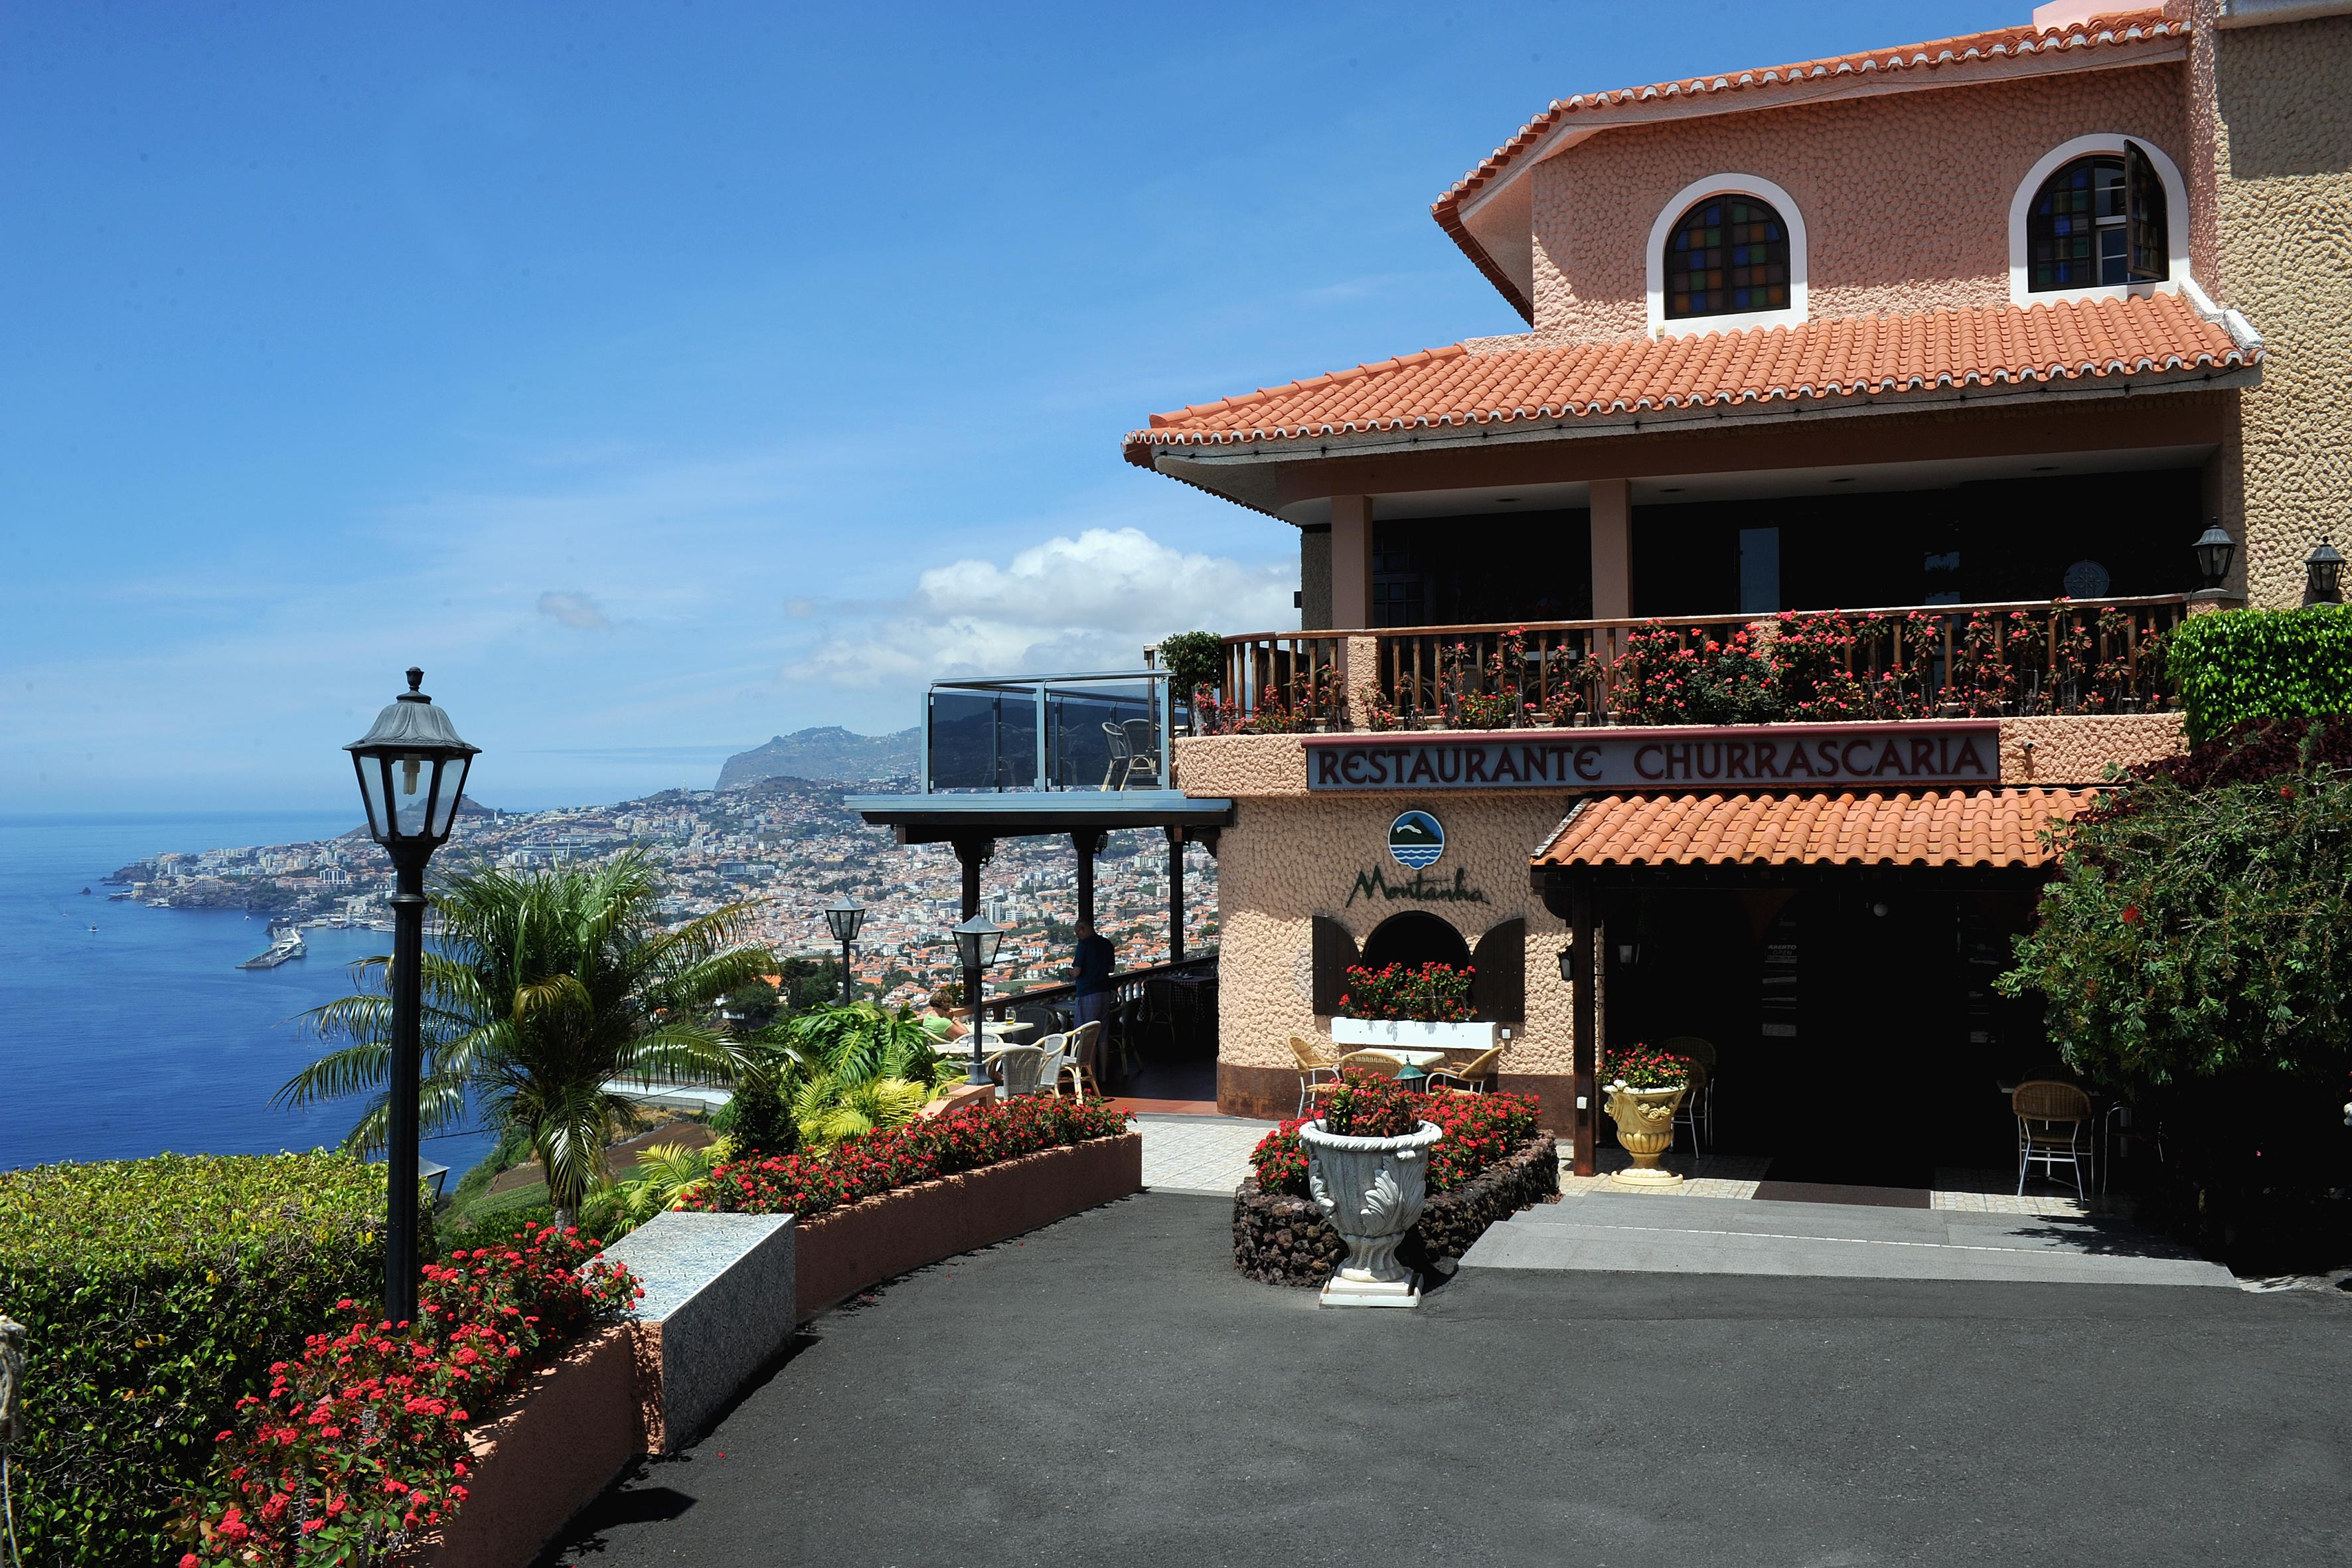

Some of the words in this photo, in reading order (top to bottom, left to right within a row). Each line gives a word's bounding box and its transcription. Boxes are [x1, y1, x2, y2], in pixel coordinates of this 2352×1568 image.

[1317, 745, 1603, 785] RESTAURANTE
[1633, 736, 1988, 780] CHURRASCARIA
[1345, 864, 1491, 908] Montanha
